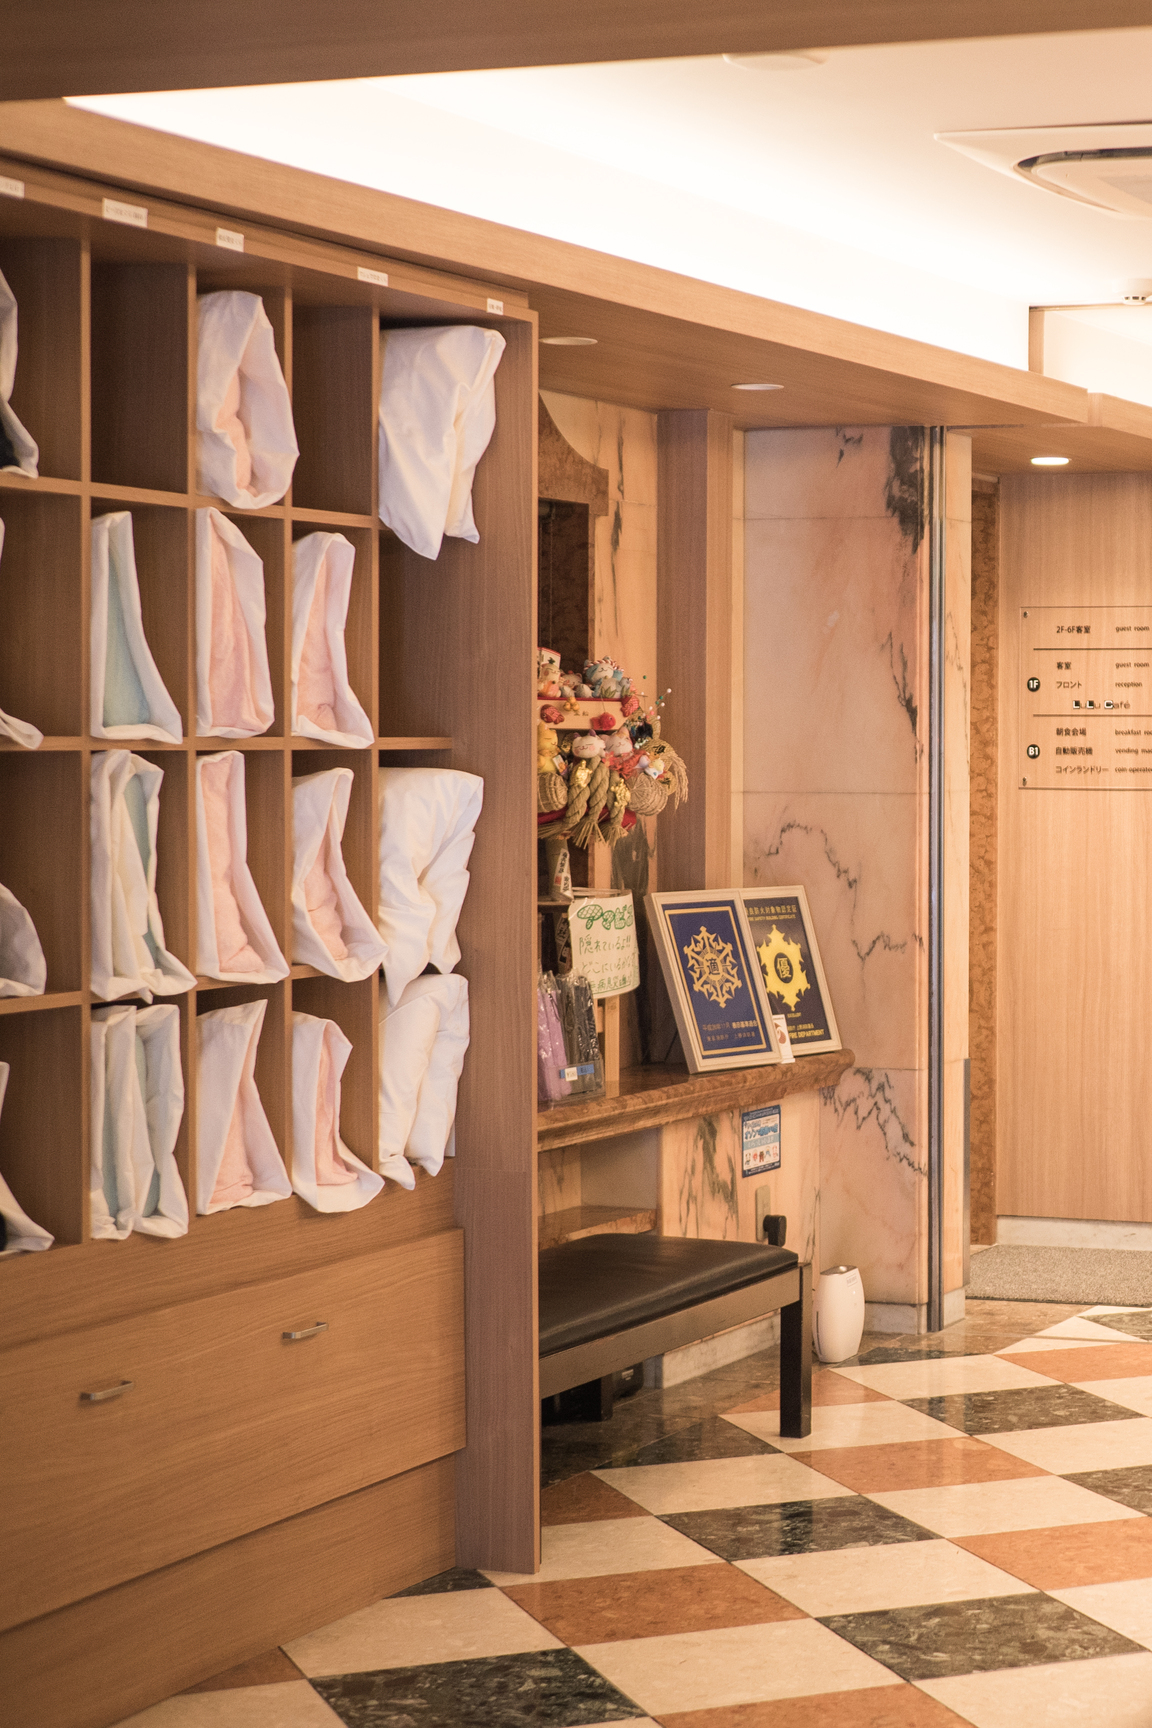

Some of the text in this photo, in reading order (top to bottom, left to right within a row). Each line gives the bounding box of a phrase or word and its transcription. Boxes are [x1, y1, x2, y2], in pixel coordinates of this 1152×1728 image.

[1056, 625, 1091, 634] 2F-6F客室
[1056, 662, 1072, 670] 客室
[1028, 679, 1039, 690] 1F
[1056, 681, 1082, 689] フロント
[1056, 727, 1087, 736] 朝食会場
[1028, 746, 1039, 756] B1
[1055, 746, 1093, 755] 自動販売機
[1115, 747, 1139, 755] vending
[1055, 765, 1109, 775] コインランドリー
[706, 958, 720, 975] 適
[777, 957, 792, 979] 優
